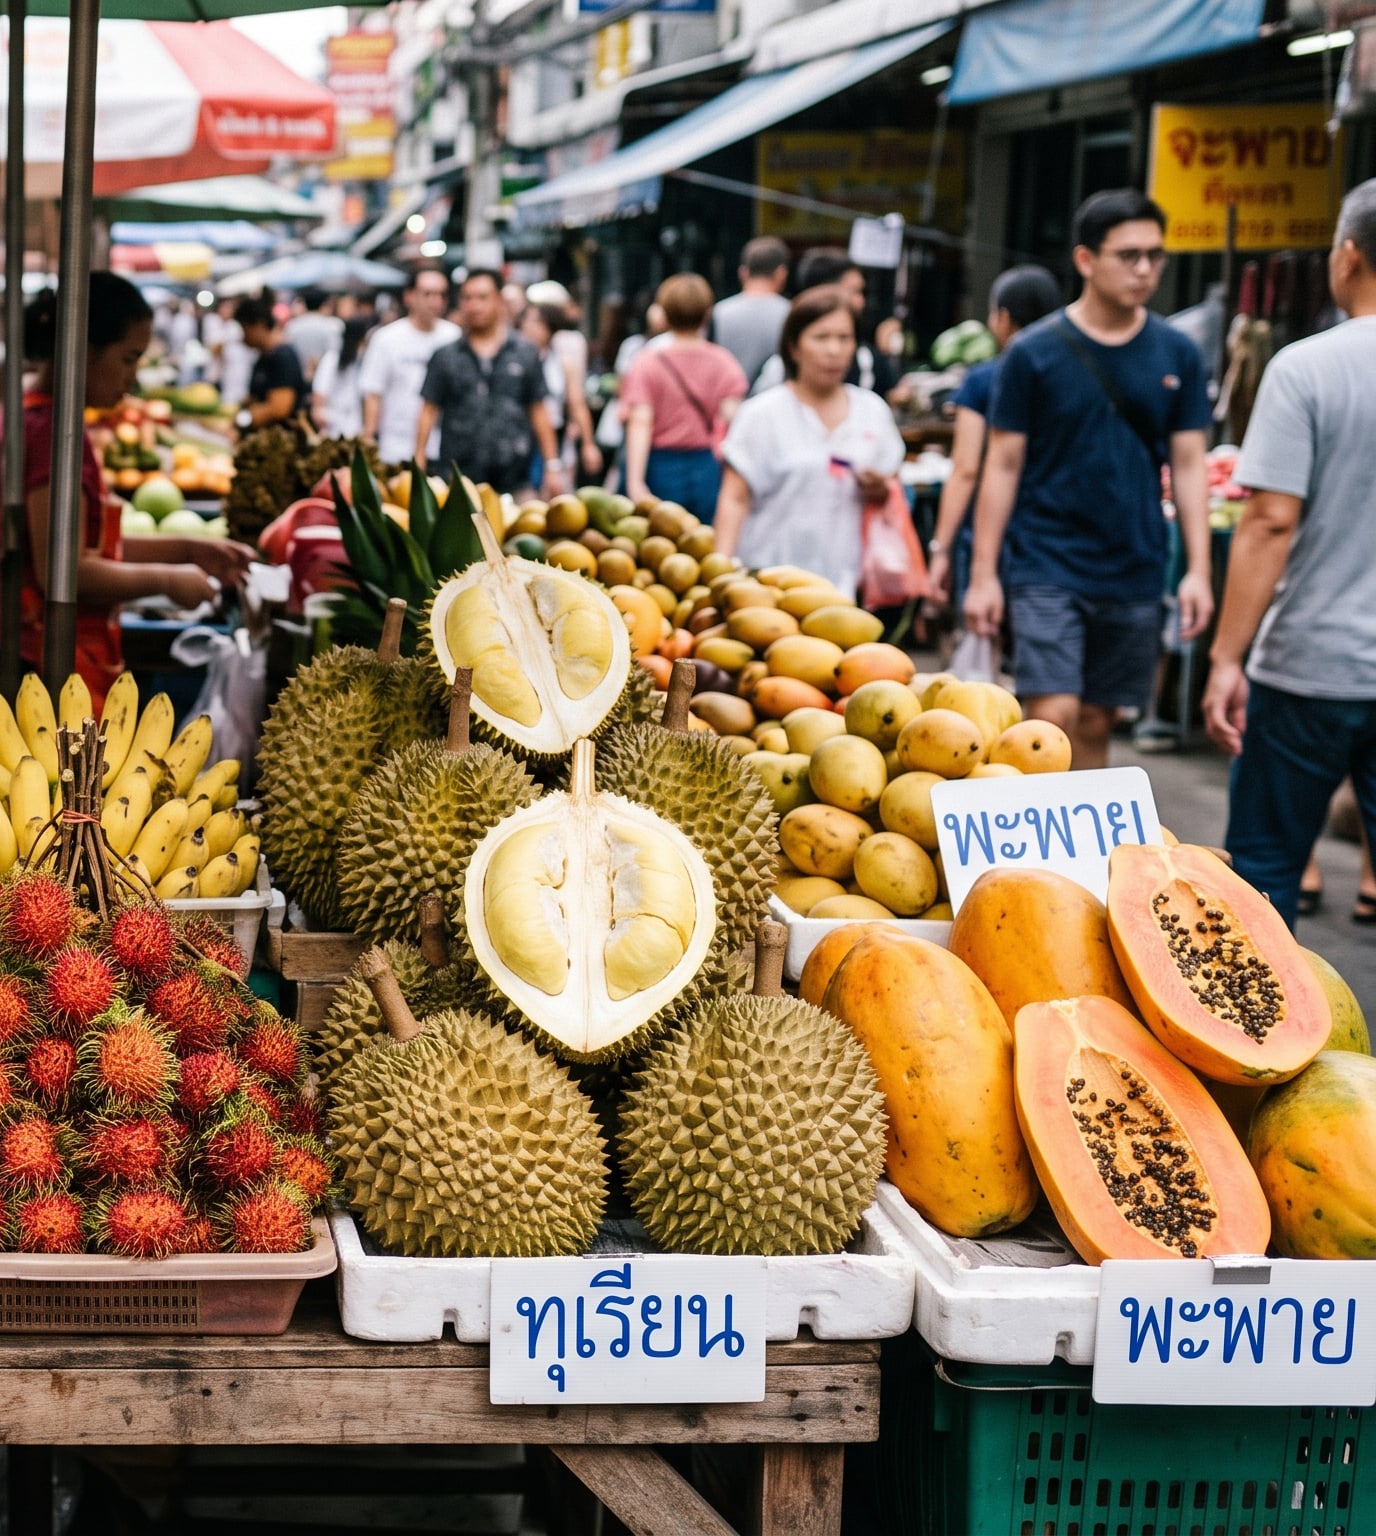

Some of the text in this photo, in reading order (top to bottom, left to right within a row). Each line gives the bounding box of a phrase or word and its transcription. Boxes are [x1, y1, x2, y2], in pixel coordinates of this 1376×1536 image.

[943, 800, 1146, 866] พะพาย
[516, 1263, 745, 1393] ทุเรียน
[1120, 1296, 1356, 1364] พะพาย
